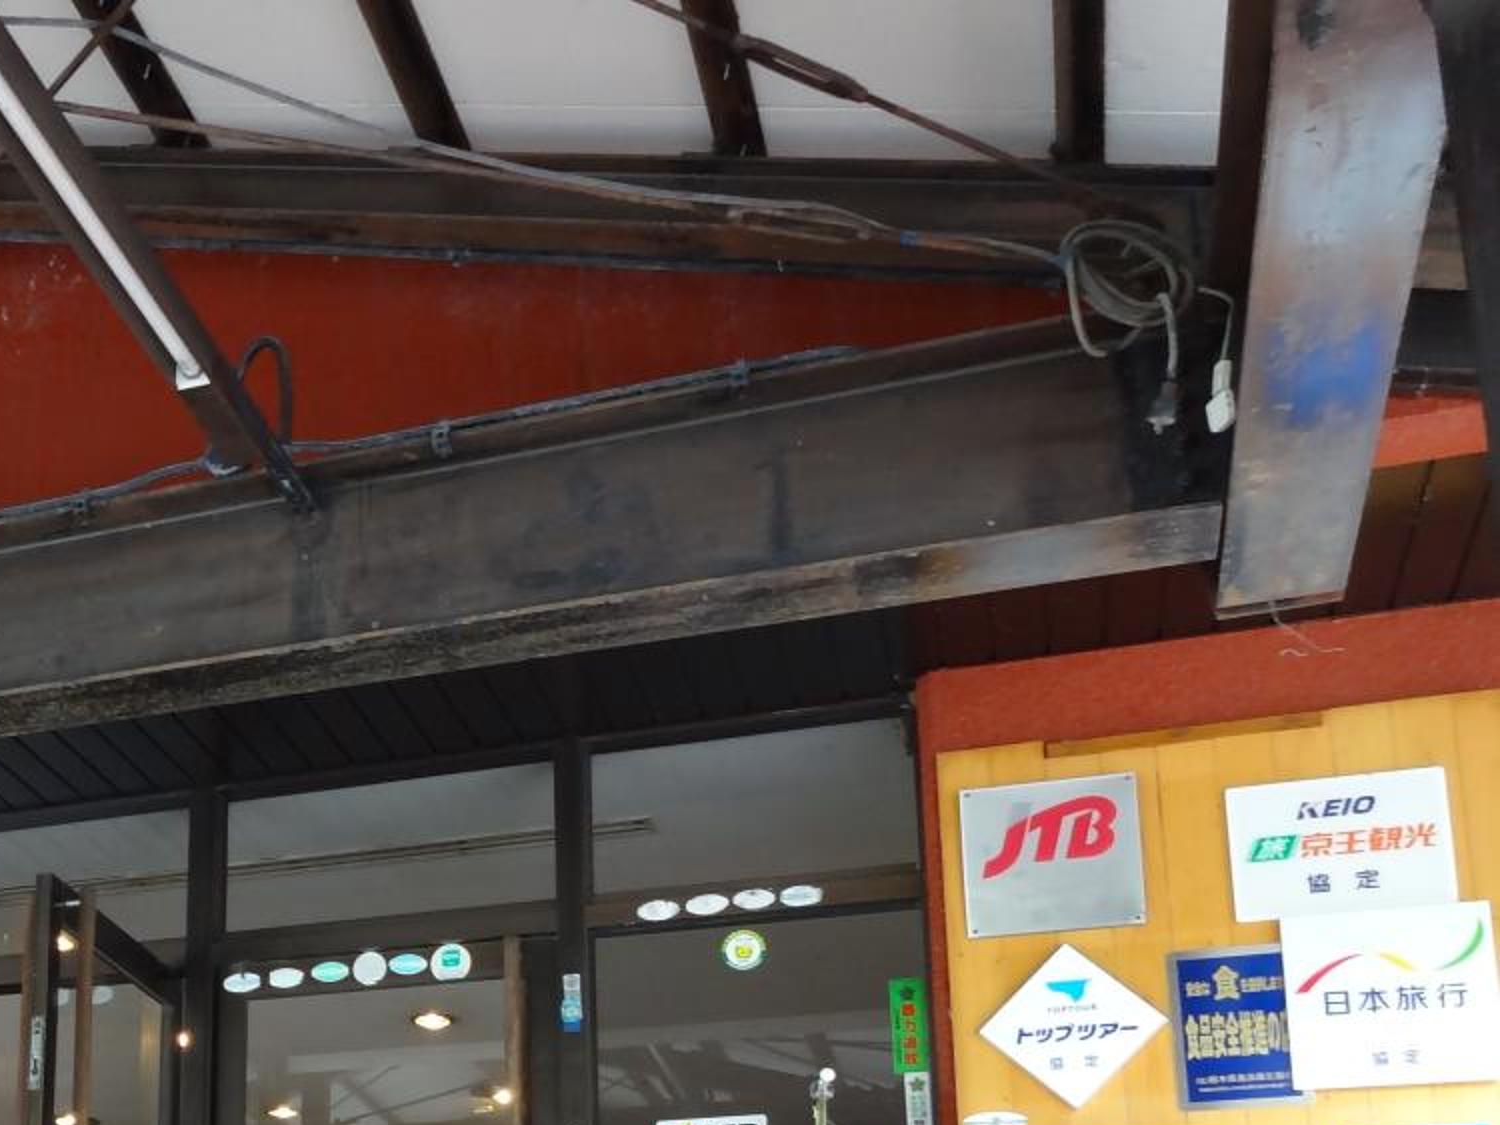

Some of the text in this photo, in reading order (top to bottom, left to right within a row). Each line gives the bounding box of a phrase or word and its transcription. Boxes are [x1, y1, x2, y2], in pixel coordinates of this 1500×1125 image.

[1297, 796, 1375, 820] KEIO
[982, 795, 1118, 880] JTB
[1323, 981, 1469, 1016] 日本旅行
[1016, 1021, 1140, 1045] トップツアー
